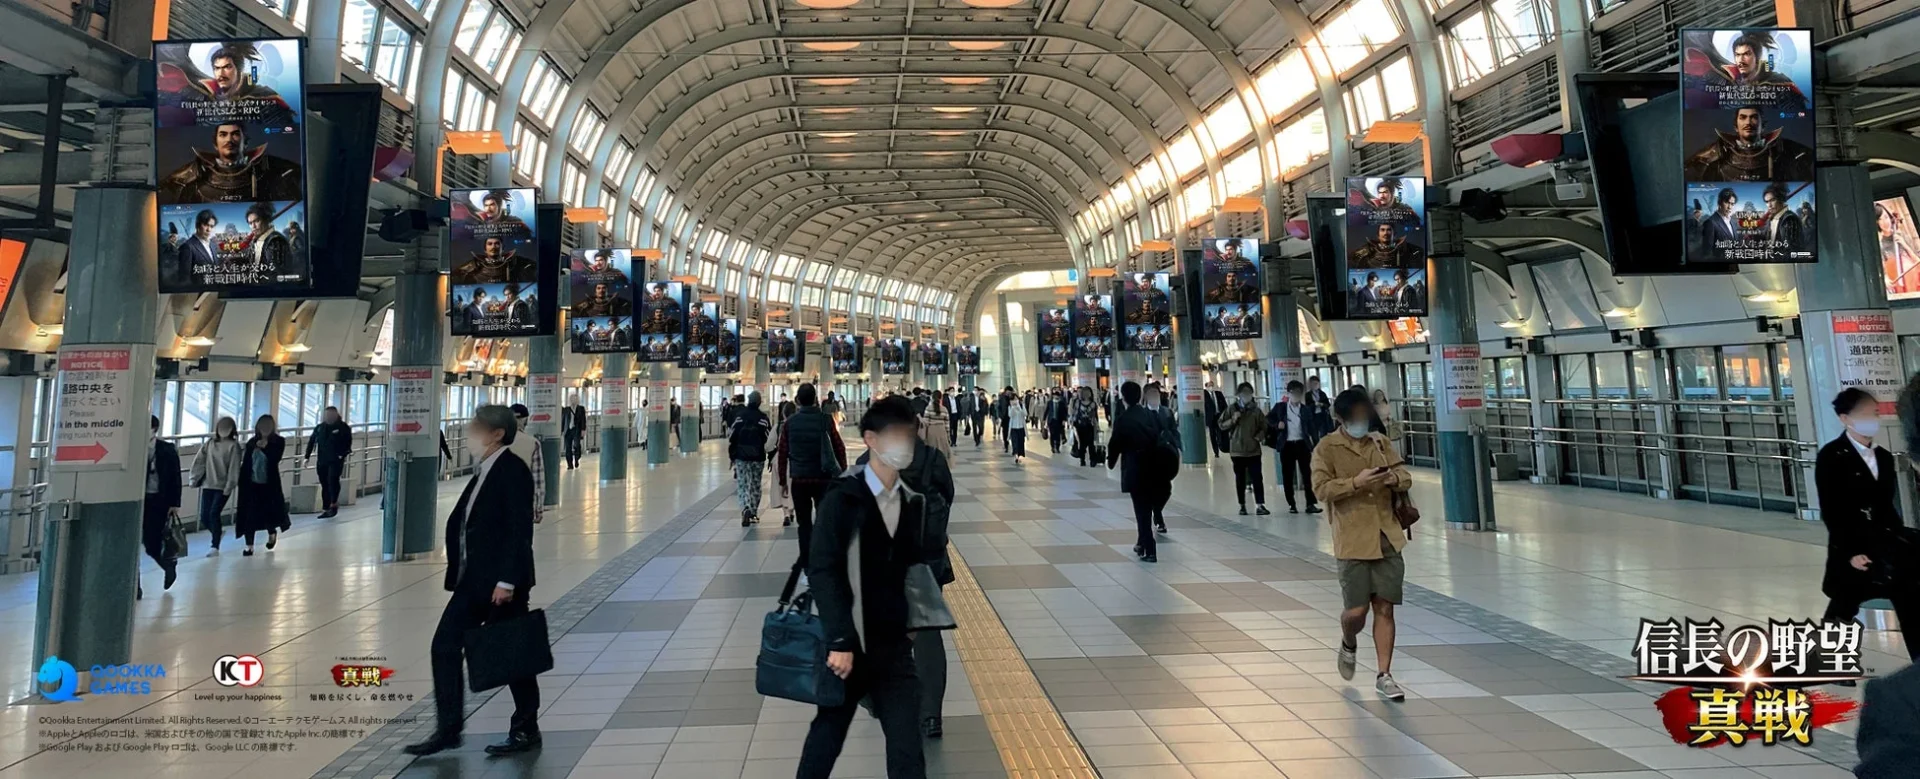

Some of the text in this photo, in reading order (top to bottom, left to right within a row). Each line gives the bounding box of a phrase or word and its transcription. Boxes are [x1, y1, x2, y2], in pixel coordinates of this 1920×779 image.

[1841, 378, 1863, 386] walk
[1865, 378, 1874, 386] in
[1876, 378, 1888, 386] the
[64, 421, 73, 429] in
[74, 420, 89, 429] the
[91, 419, 124, 428] middle
